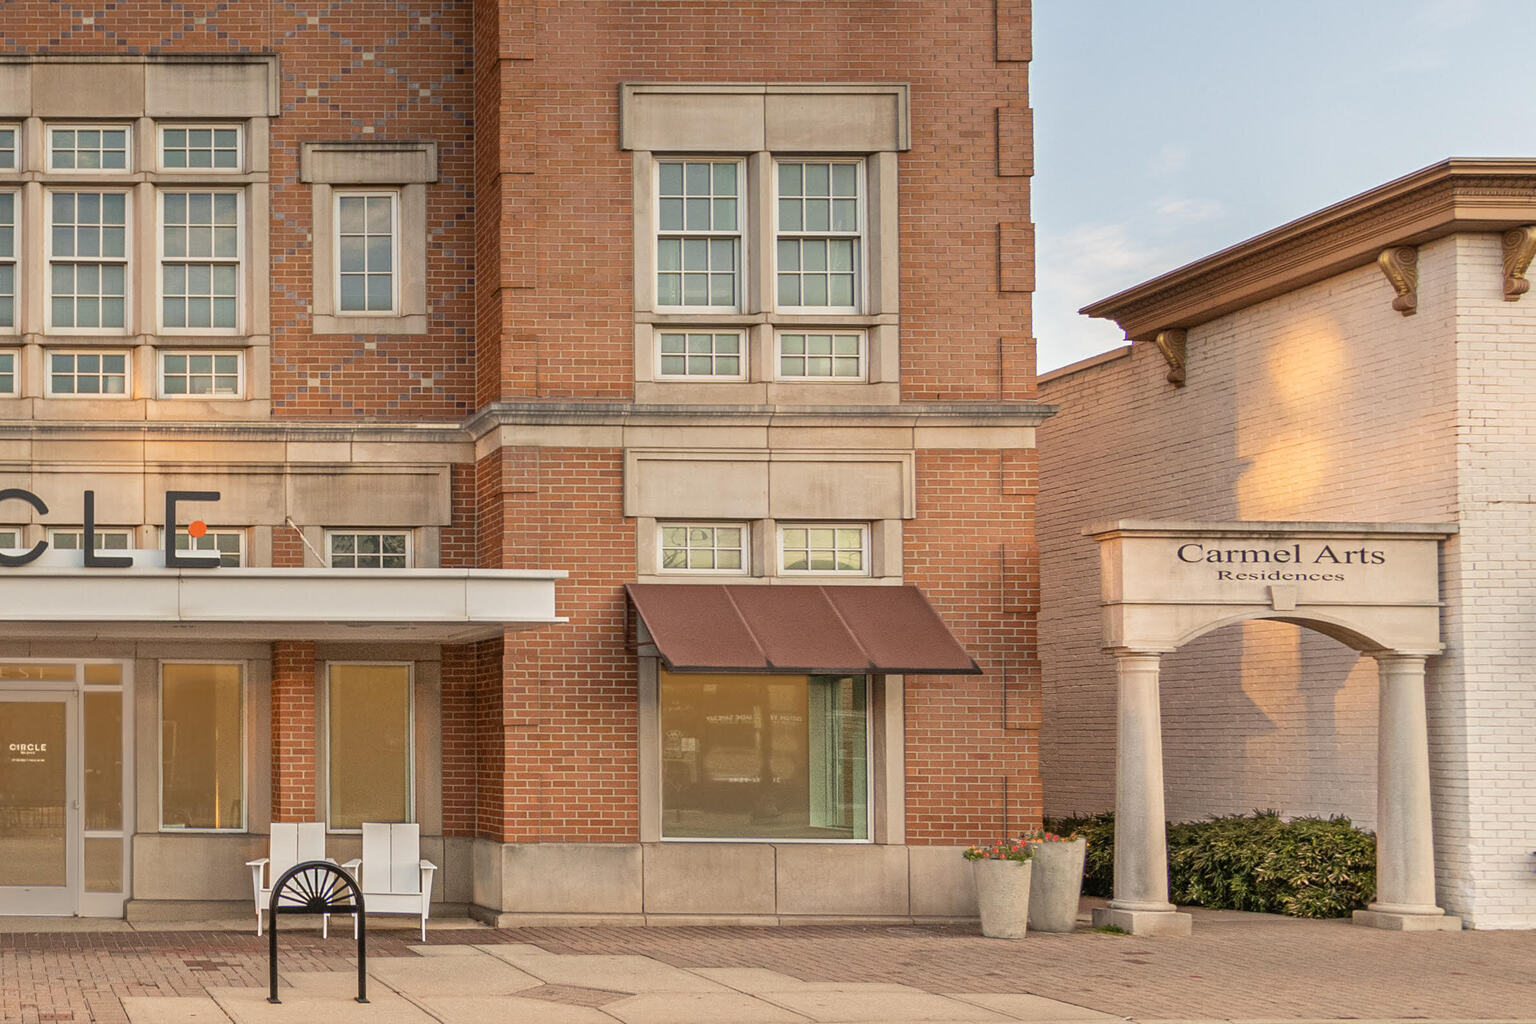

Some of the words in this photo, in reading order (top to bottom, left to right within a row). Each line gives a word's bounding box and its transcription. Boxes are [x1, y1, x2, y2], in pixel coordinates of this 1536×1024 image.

[1177, 543, 1301, 564] Carmel
[1312, 544, 1386, 565] Arts
[1217, 570, 1345, 582] Residences
[9, 743, 47, 752] CIRCLE
